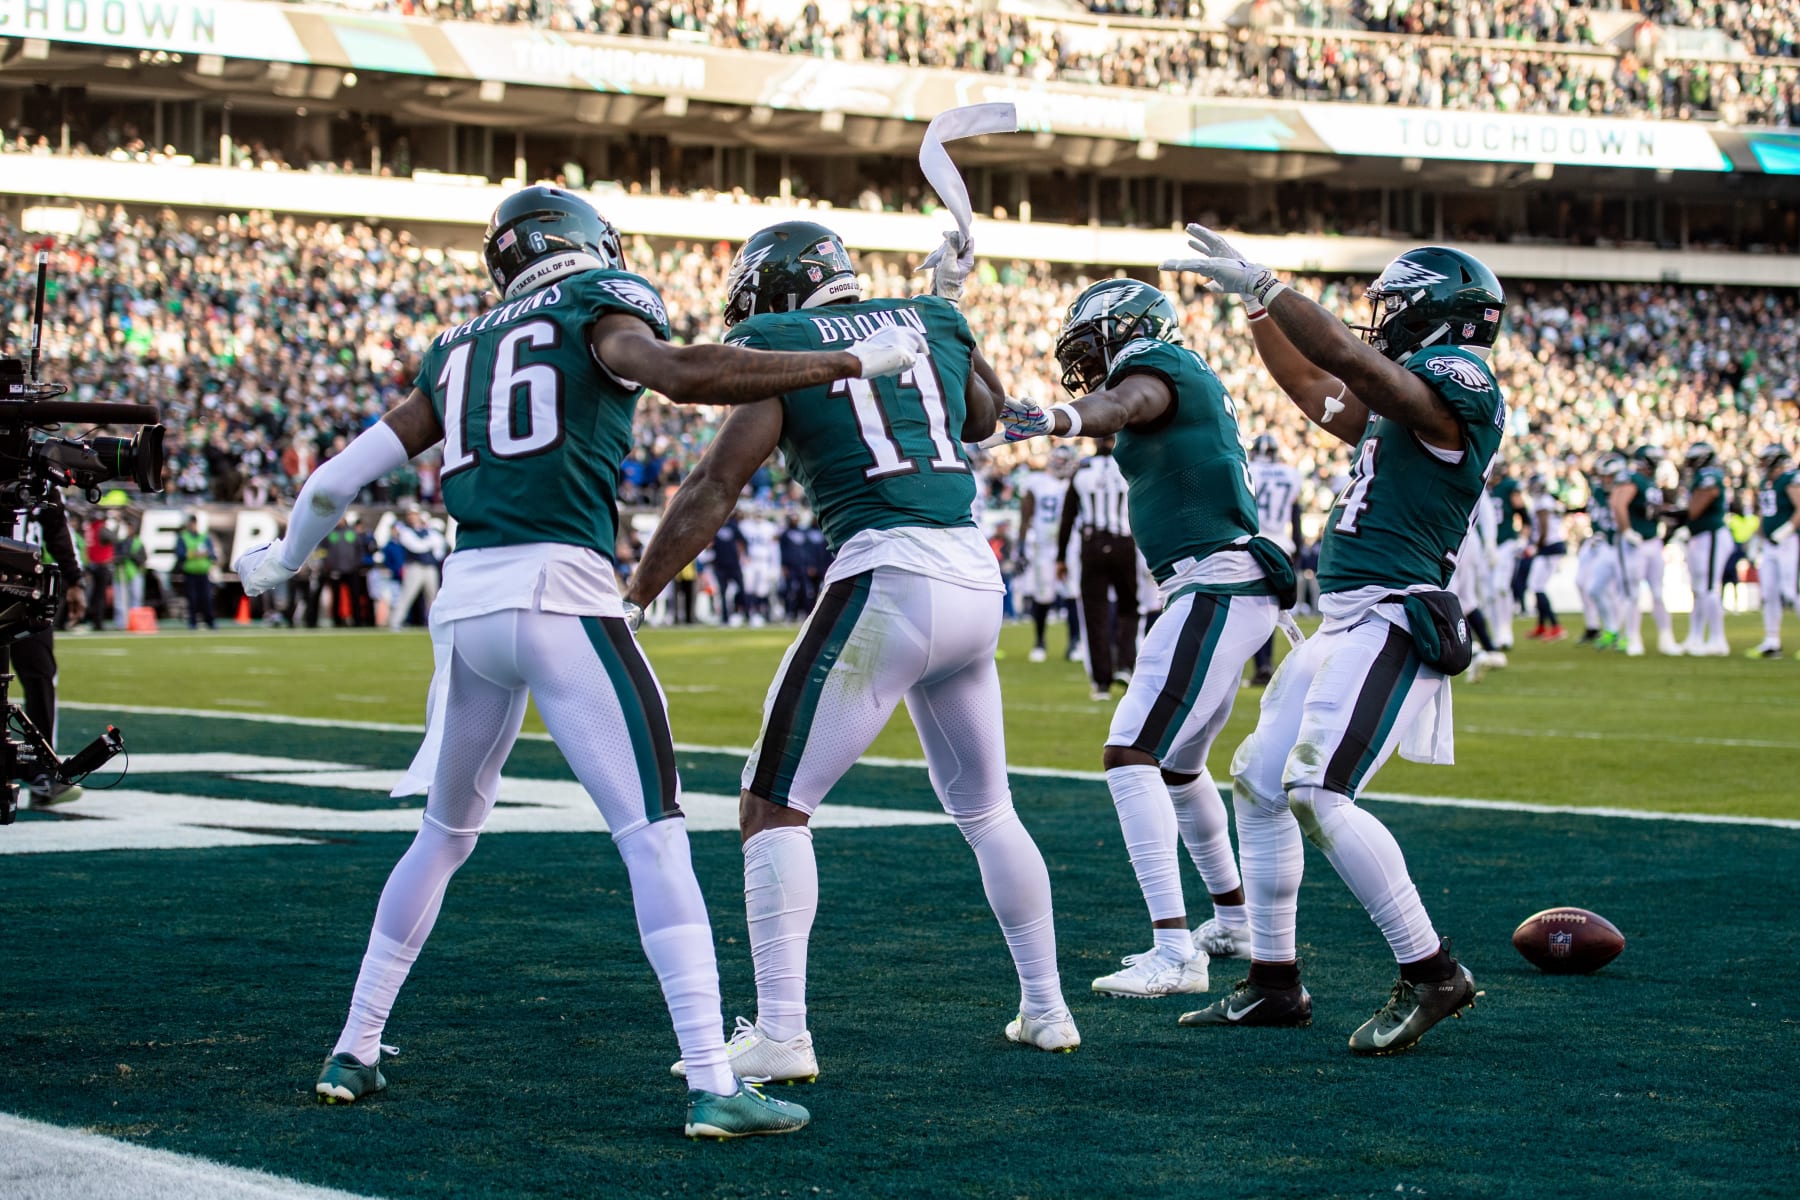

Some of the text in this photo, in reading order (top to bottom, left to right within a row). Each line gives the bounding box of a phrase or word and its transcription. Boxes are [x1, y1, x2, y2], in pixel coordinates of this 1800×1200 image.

[0, 0, 214, 43] HDOWN
[1398, 117, 1655, 157] TOUCHDOWN
[516, 274, 537, 290] TAKES
[537, 266, 551, 278] ALL
[553, 261, 563, 270] OF
[565, 259, 576, 268] US
[439, 284, 562, 347] WATKINS
[810, 306, 928, 344] BROWN
[436, 317, 564, 478] 16
[829, 352, 970, 481] 11
[1256, 481, 1293, 523] 47
